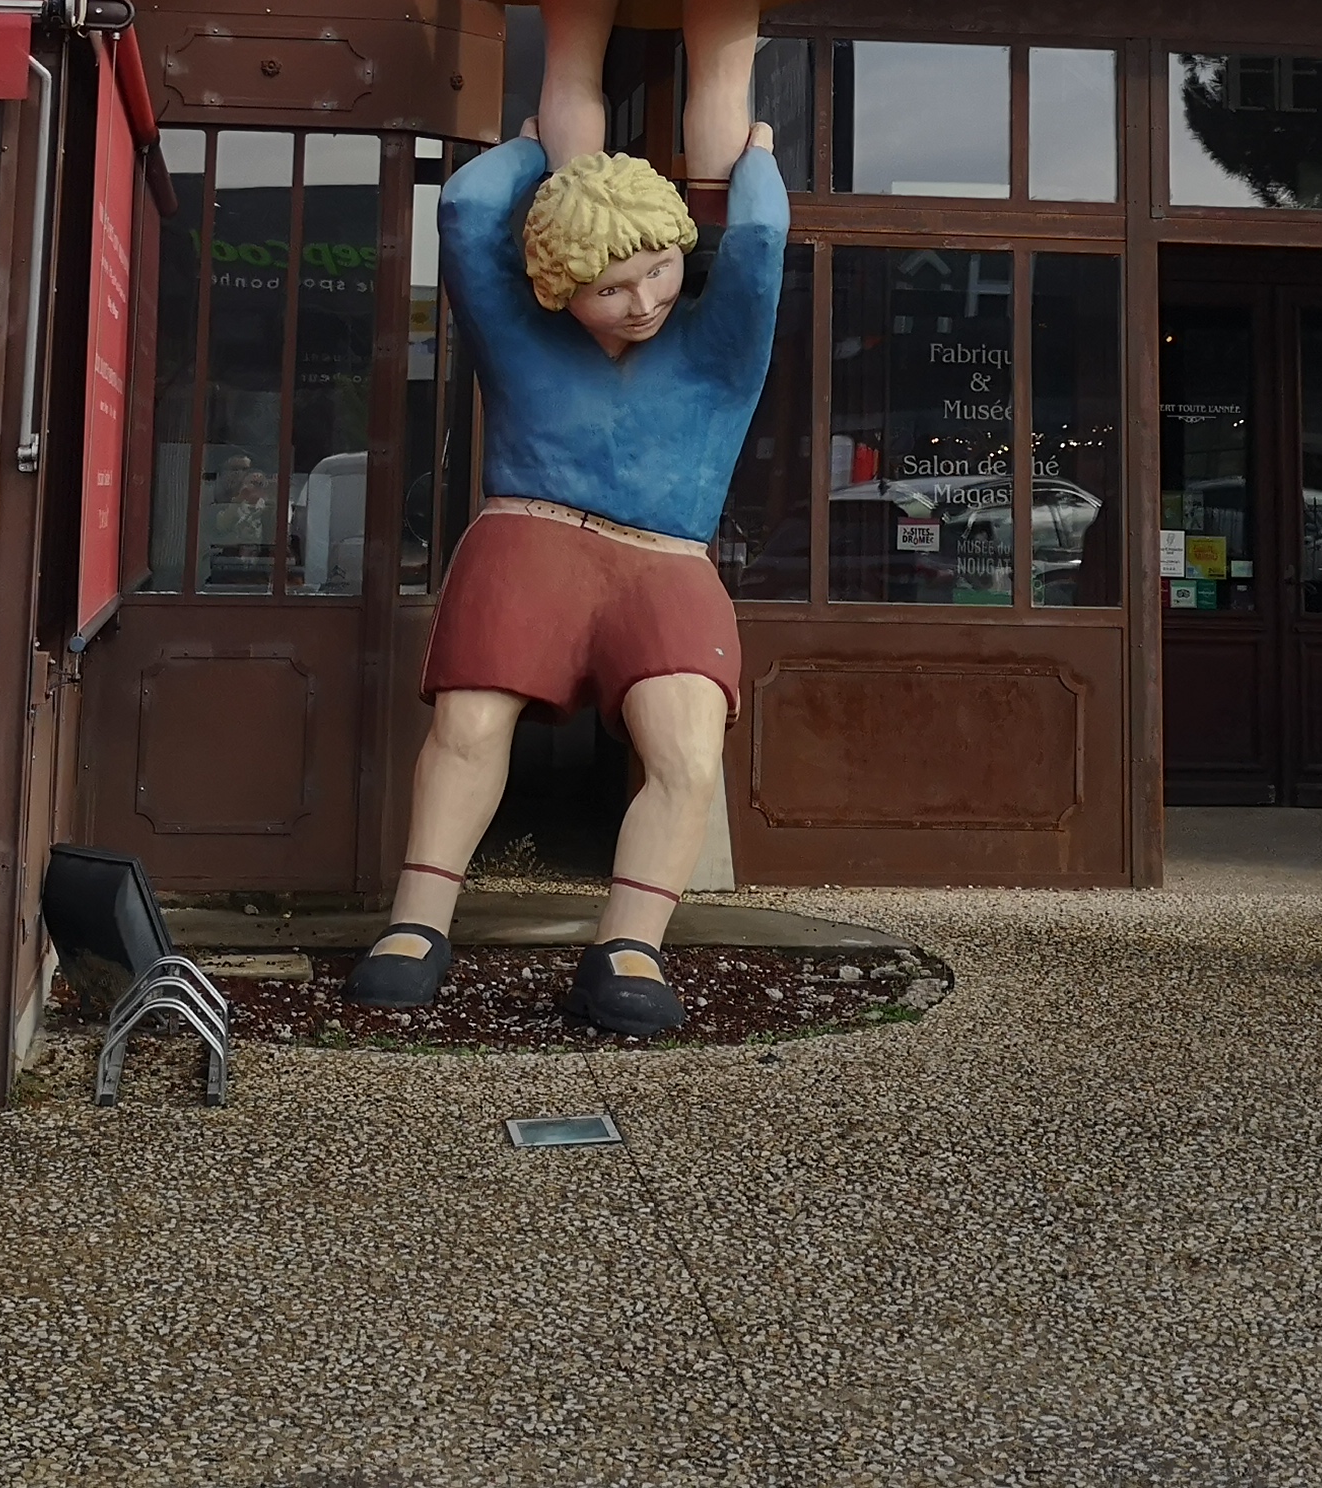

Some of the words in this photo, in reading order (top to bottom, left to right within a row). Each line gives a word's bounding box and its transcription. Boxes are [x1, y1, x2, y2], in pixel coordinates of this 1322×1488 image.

[929, 343, 1012, 369] Fabriqu
[970, 372, 992, 392] &
[1177, 404, 1207, 413] TOUTE
[903, 454, 970, 477] Salon
[977, 455, 1007, 475] de
[1032, 454, 1060, 476] hé
[957, 557, 1012, 575] NOUGAT
